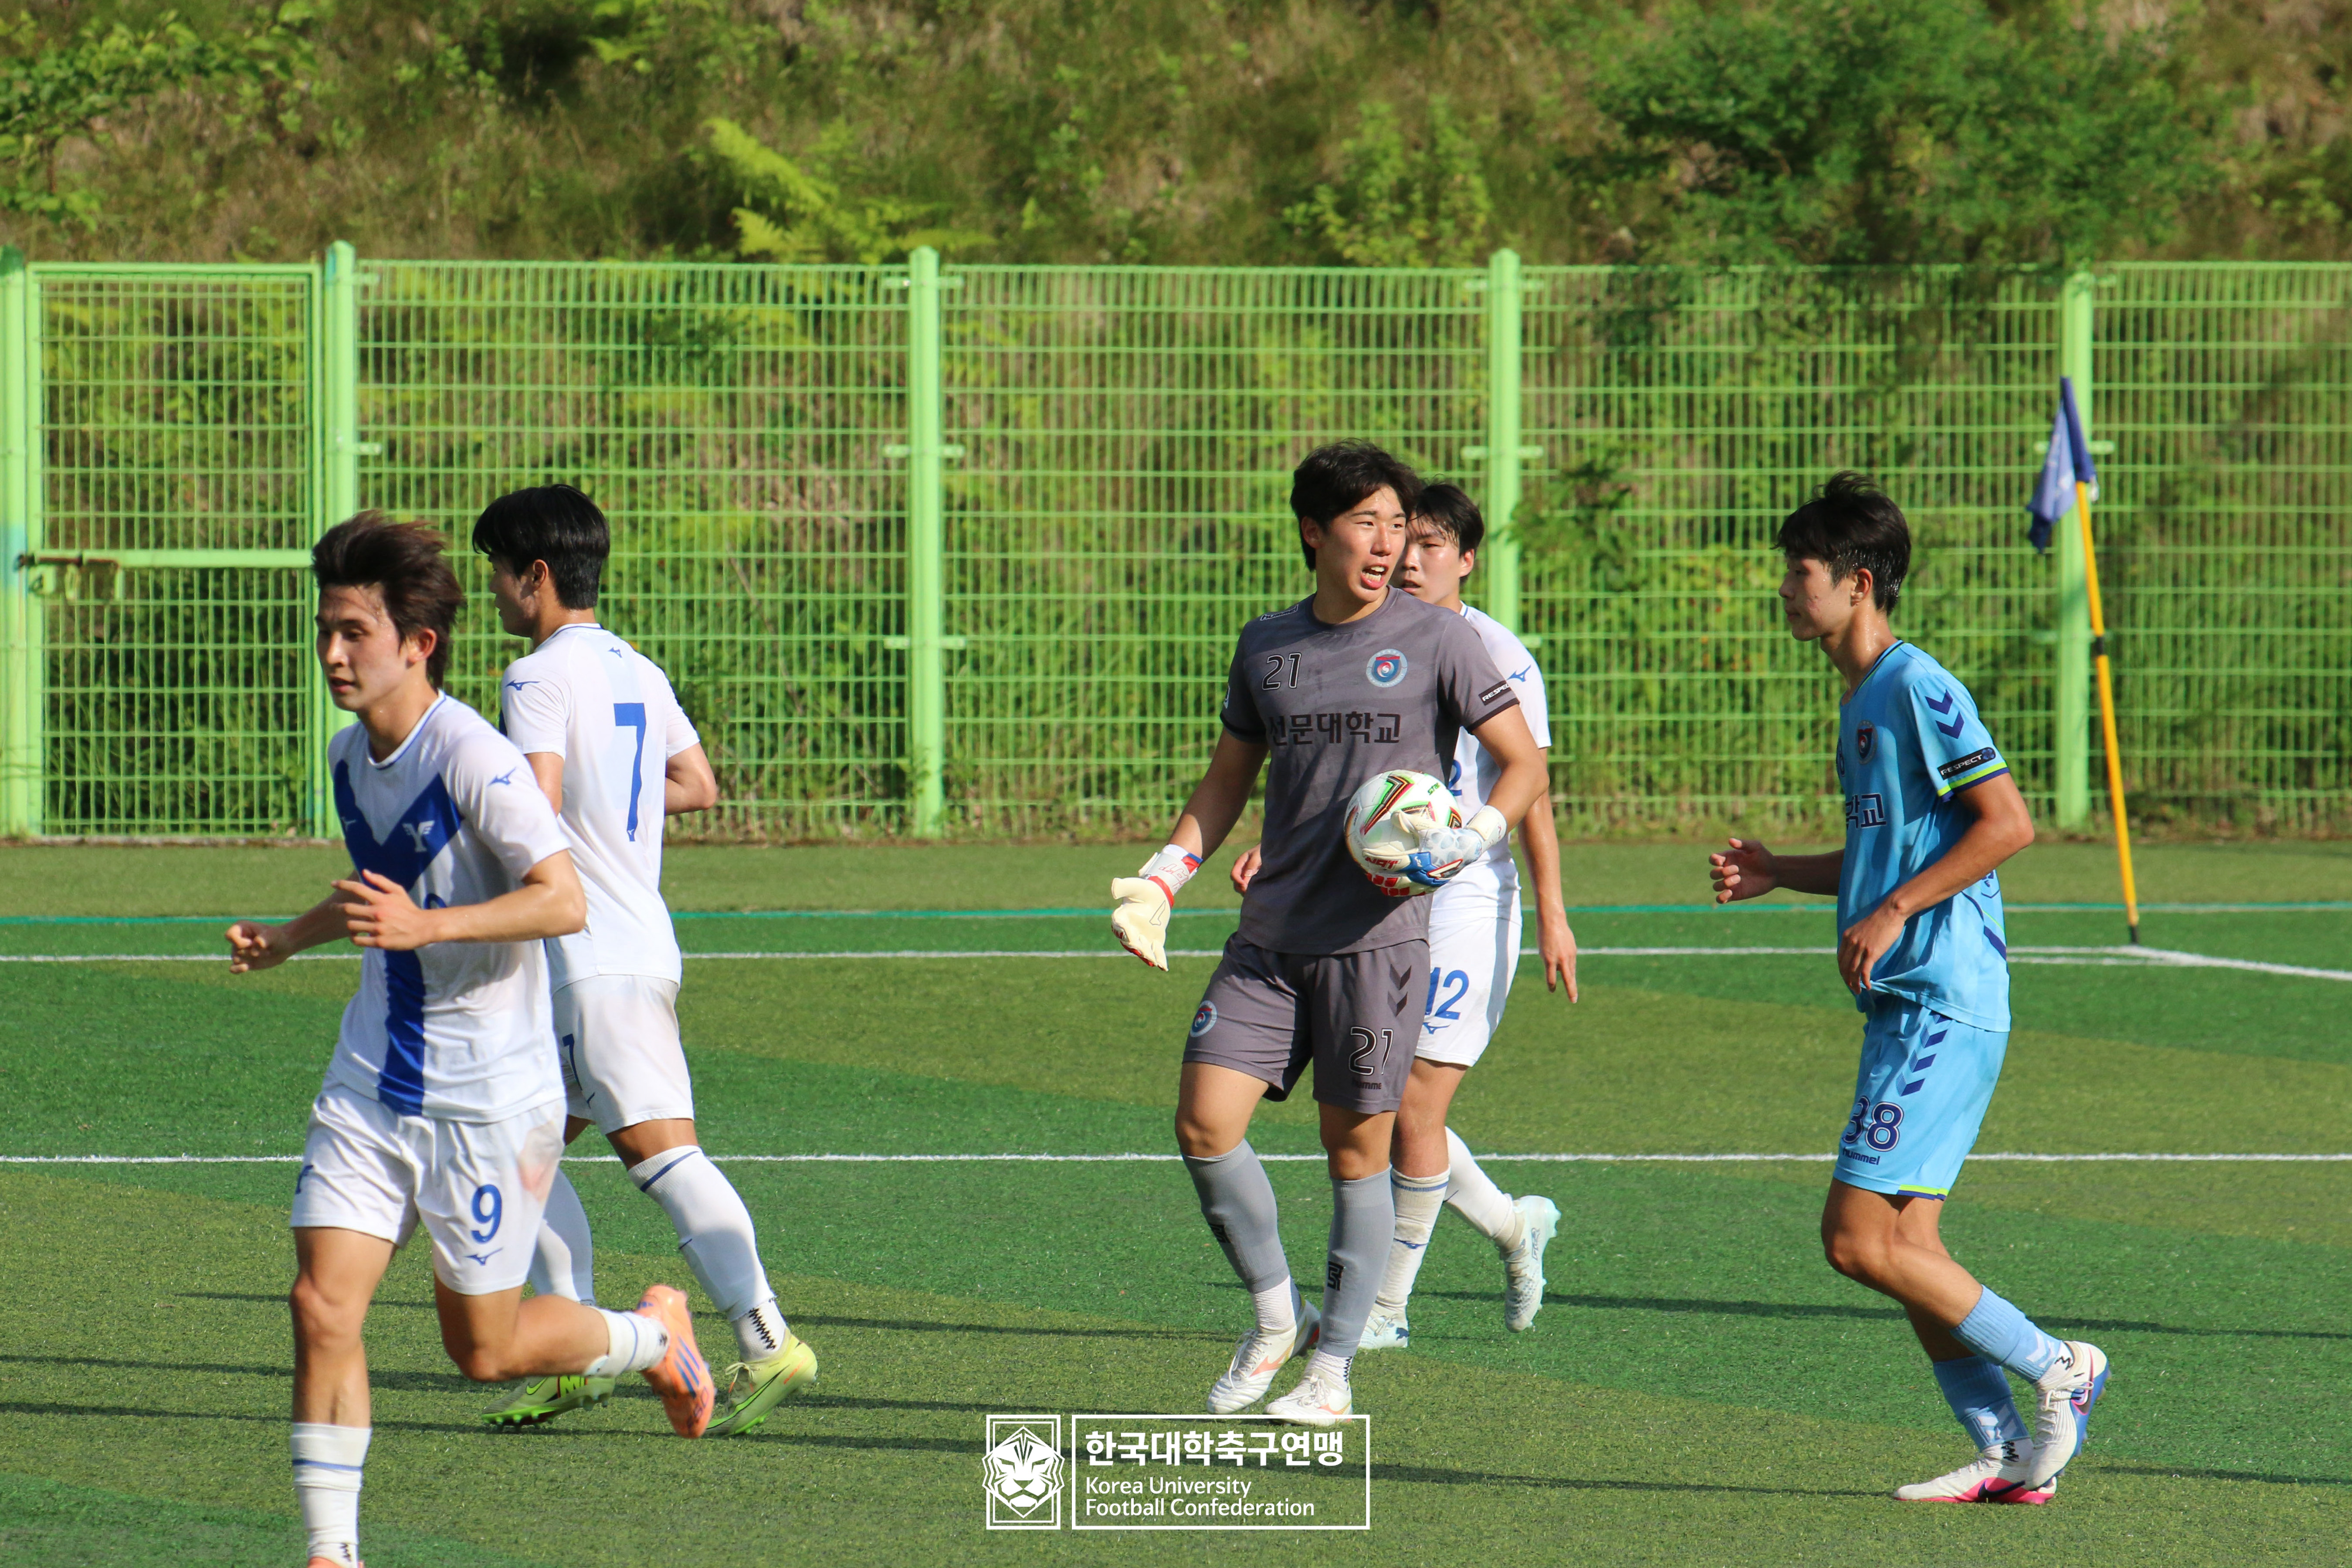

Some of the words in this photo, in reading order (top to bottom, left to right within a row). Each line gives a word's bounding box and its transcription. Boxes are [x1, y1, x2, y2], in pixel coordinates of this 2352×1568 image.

[1262, 652, 1302, 690] 21
[1268, 711, 1401, 745] 선문대학교
[613, 703, 647, 842] 7
[1940, 754, 1983, 776] RESPECT
[1425, 967, 1469, 1020] 12
[1349, 1026, 1393, 1075] 21
[1842, 1096, 1904, 1152] 38
[1843, 1148, 1881, 1165] hummel
[470, 1184, 502, 1244] 9
